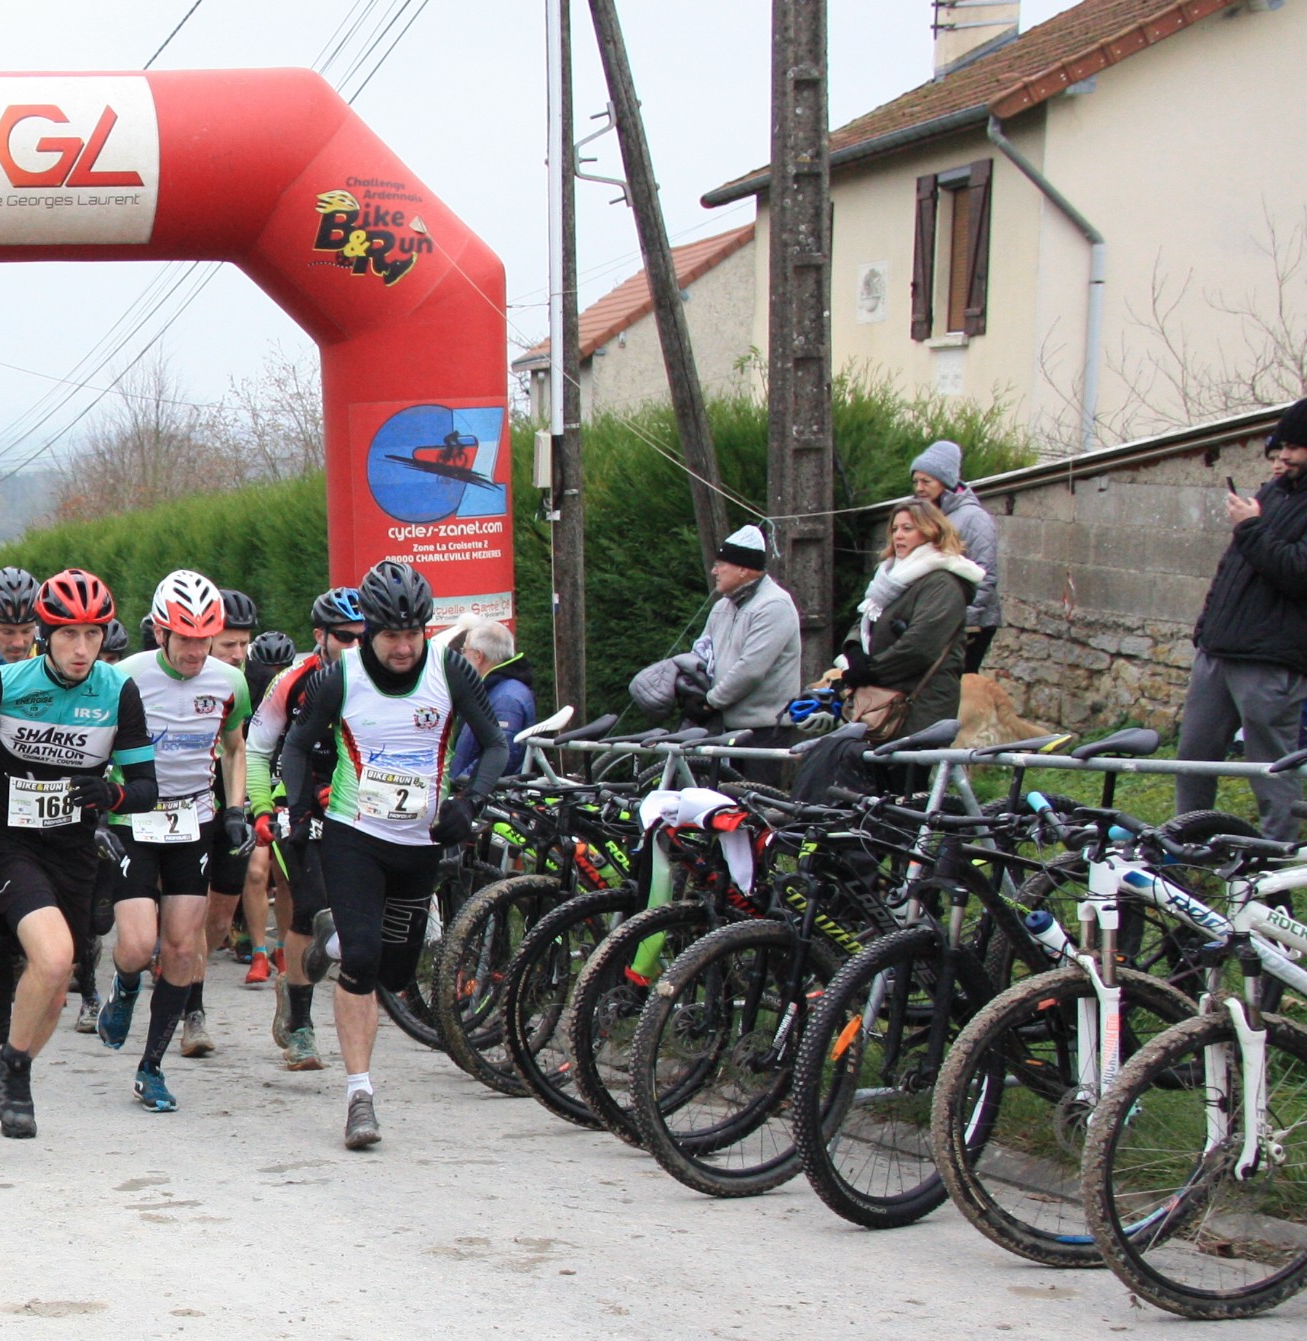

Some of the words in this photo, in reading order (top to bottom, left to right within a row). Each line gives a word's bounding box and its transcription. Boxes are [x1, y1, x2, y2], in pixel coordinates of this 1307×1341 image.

[346, 177, 406, 190] Challenge
[7, 194, 73, 209] Georges
[78, 193, 140, 206] Laurent
[312, 202, 405, 252] Bike
[388, 521, 503, 541] cycles-zanet.com
[413, 544, 435, 552] Zone
[437, 543, 446, 551] La
[448, 541, 483, 551] Croisette
[484, 540, 489, 548] 2
[416, 551, 471, 563] CHARLEVILLE
[472, 550, 502, 560] MEZIERES
[15, 727, 88, 747] SHARKS
[12, 742, 85, 759] TRIATHLON
[16, 782, 63, 792] BIKE&RUN
[35, 795, 74, 819] 168
[395, 788, 409, 812] 2
[166, 813, 180, 834] 2
